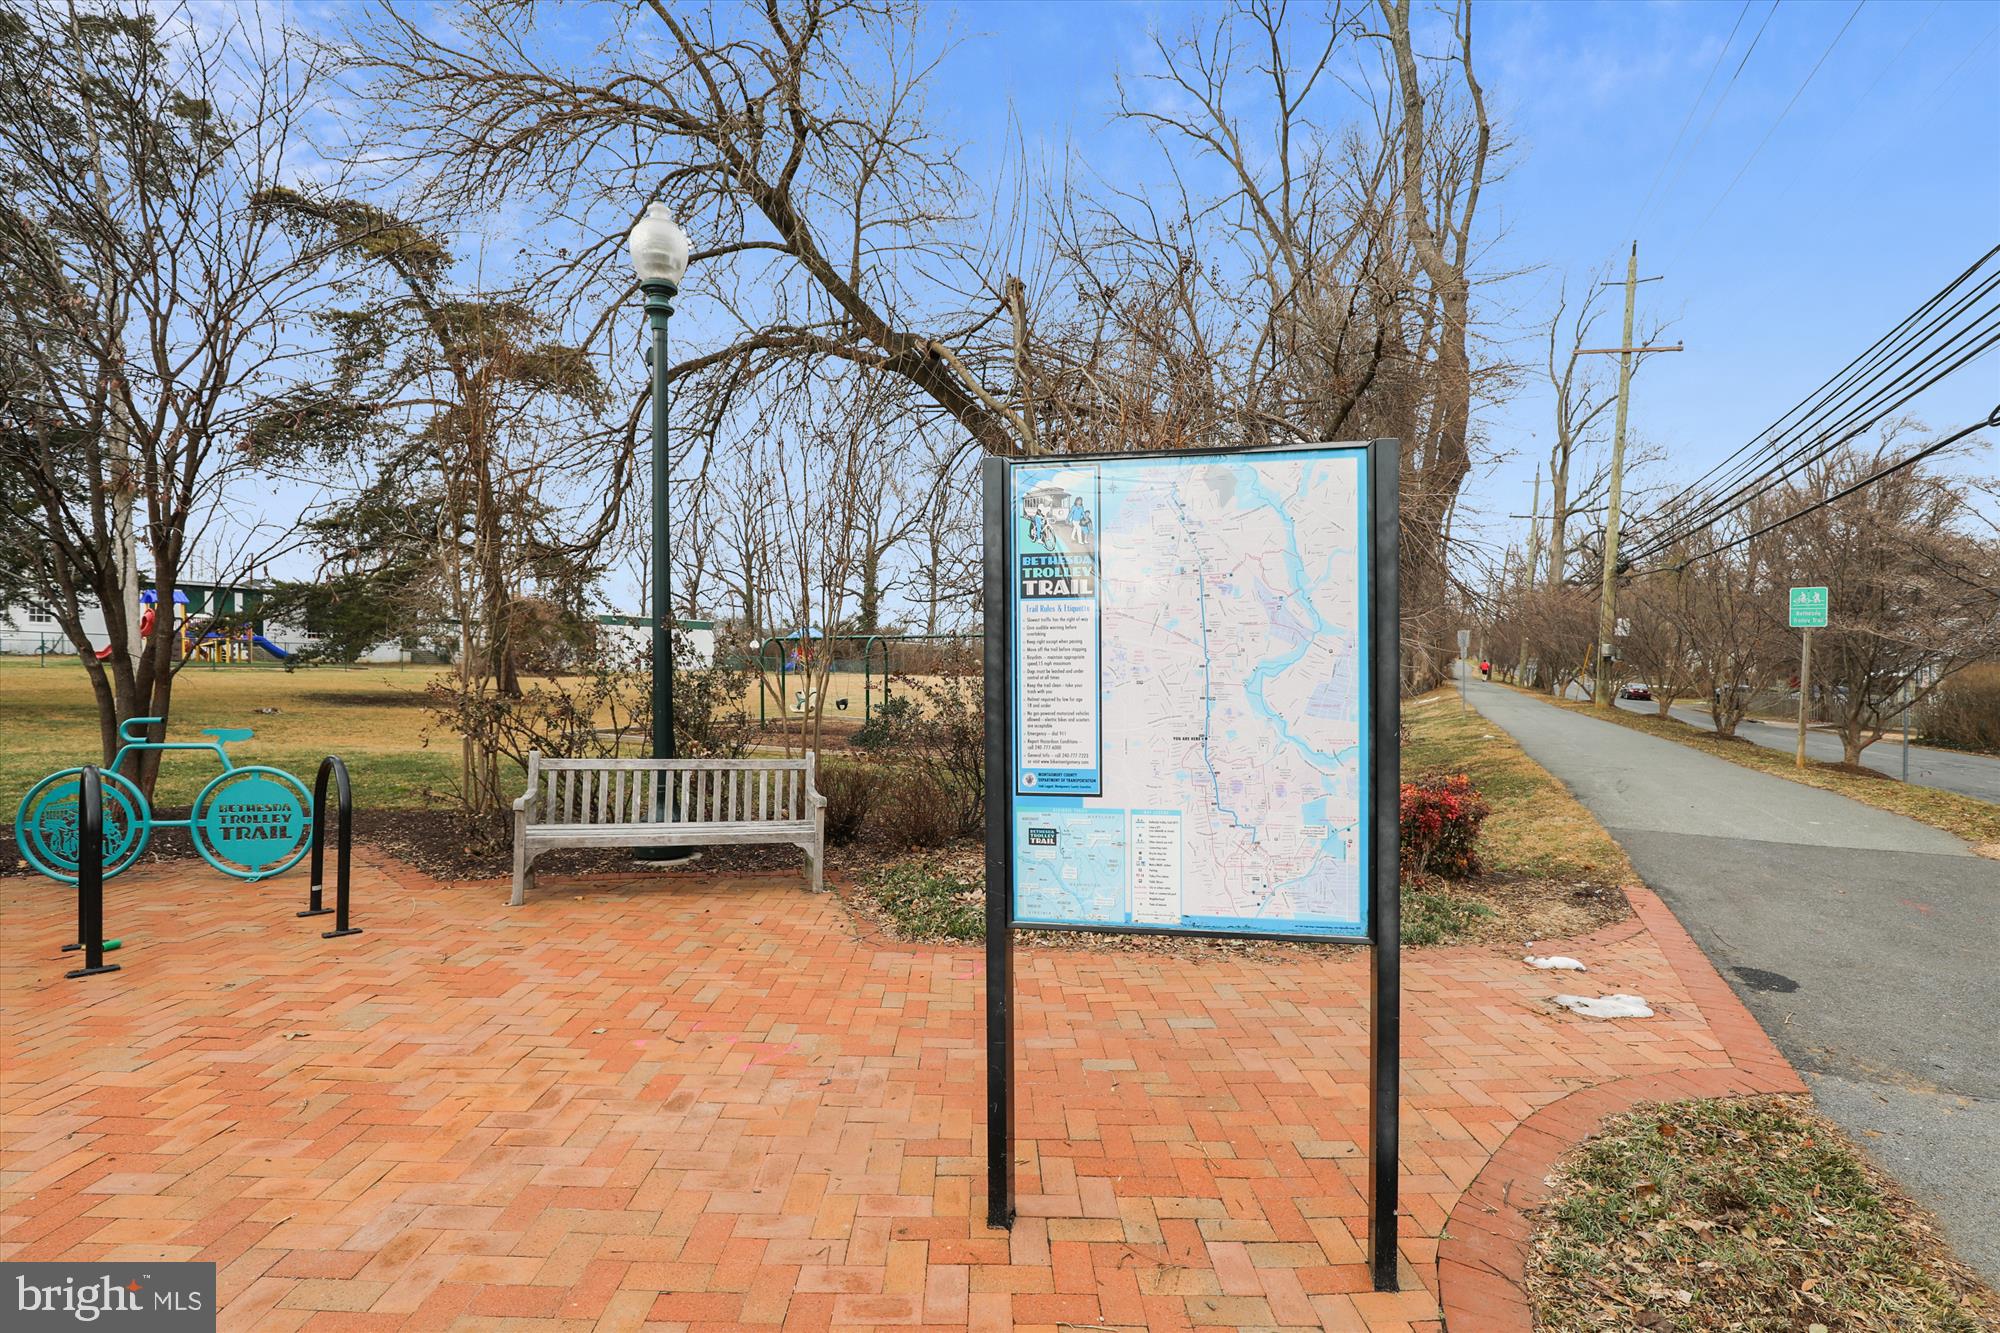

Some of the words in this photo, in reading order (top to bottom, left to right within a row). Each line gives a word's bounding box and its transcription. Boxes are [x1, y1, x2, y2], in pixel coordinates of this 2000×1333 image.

[1023, 555, 1092, 565] BETHESDA
[1022, 567, 1092, 578] TROLLEY
[1023, 579, 1093, 595] TRAIL
[218, 802, 292, 813] BETHESDA
[218, 814, 292, 824] TROLLEY
[218, 826, 293, 841] TRAIL
